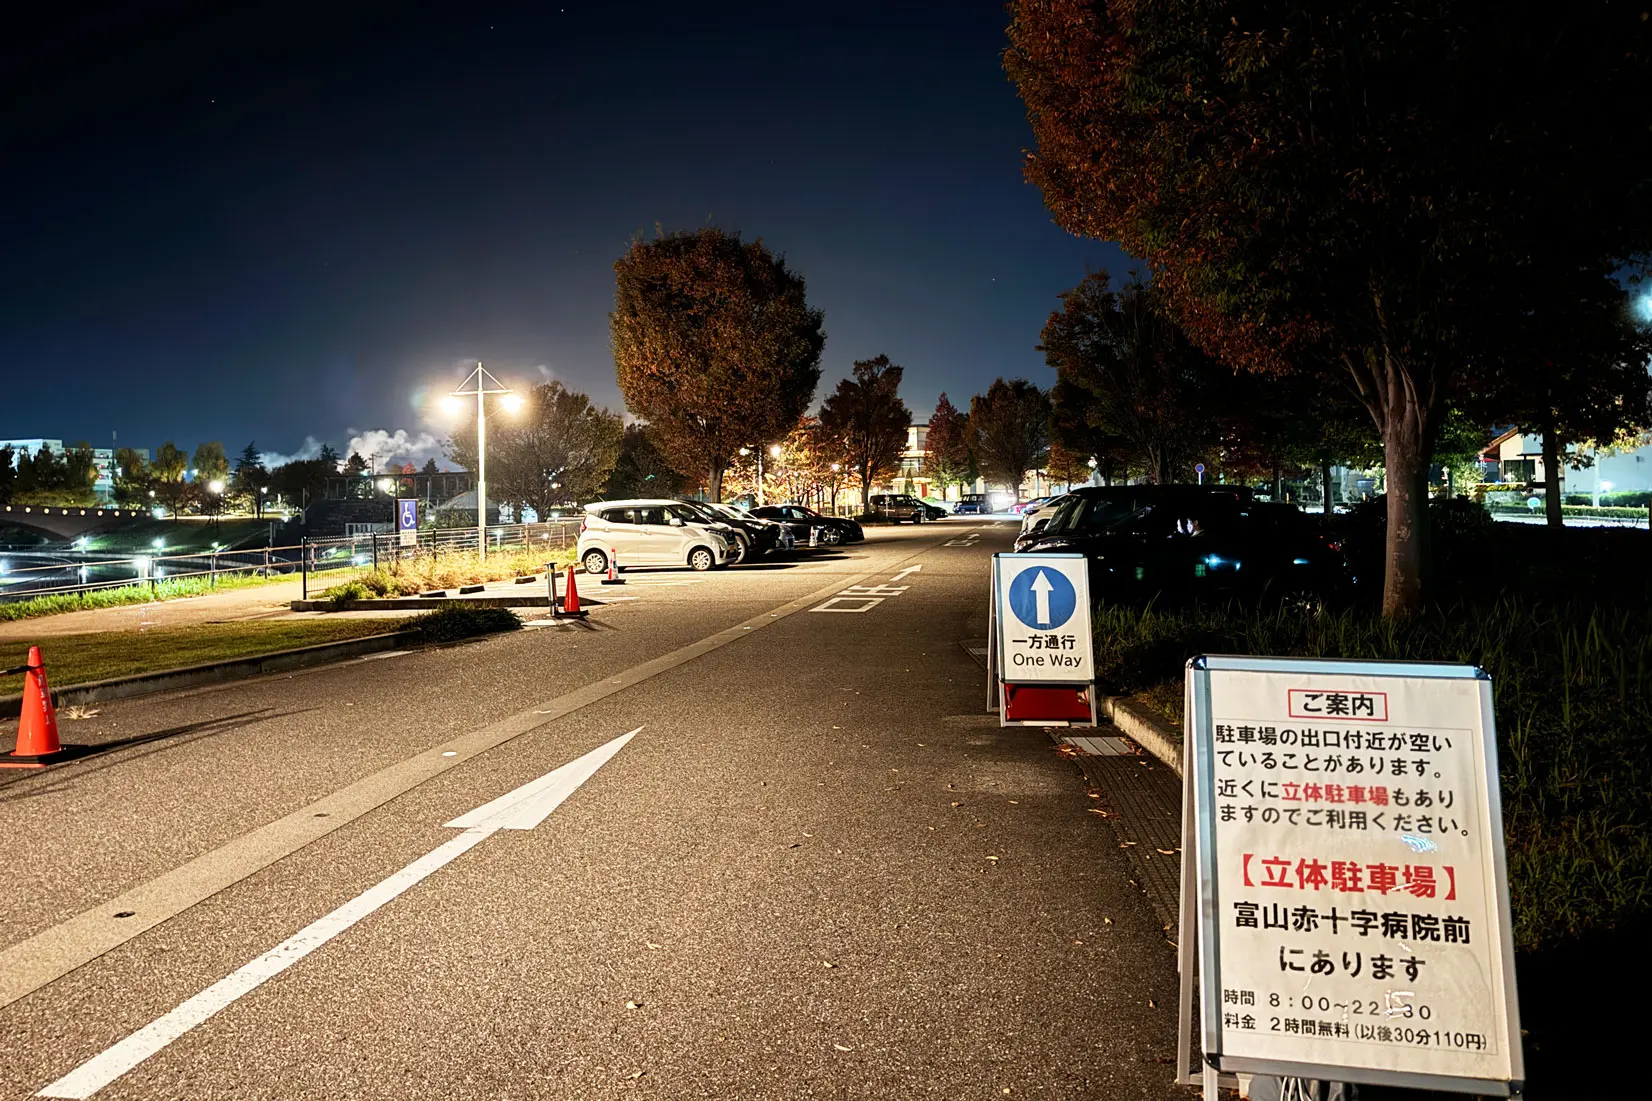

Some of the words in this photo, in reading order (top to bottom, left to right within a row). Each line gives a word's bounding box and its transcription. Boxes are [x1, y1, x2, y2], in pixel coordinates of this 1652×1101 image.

[1012, 634, 1076, 650] 一方通行
[1013, 653, 1044, 667] One
[1049, 654, 1082, 668] Way
[1302, 693, 1374, 717] ご案内
[1215, 725, 1452, 752] 駐車場の出口付近が空い
[1216, 750, 1441, 779] ていることがあります。
[1217, 779, 1454, 808] 近くに立体駐車場もあり
[1219, 804, 1469, 837] ますのでご利用ください。
[1242, 853, 1456, 901] 【立体駐車場】
[1233, 901, 1471, 944] 富山赤十字病院前
[1280, 946, 1426, 982] にあります
[1223, 989, 1255, 1007] 時間
[1224, 1013, 1256, 1030] 料金
